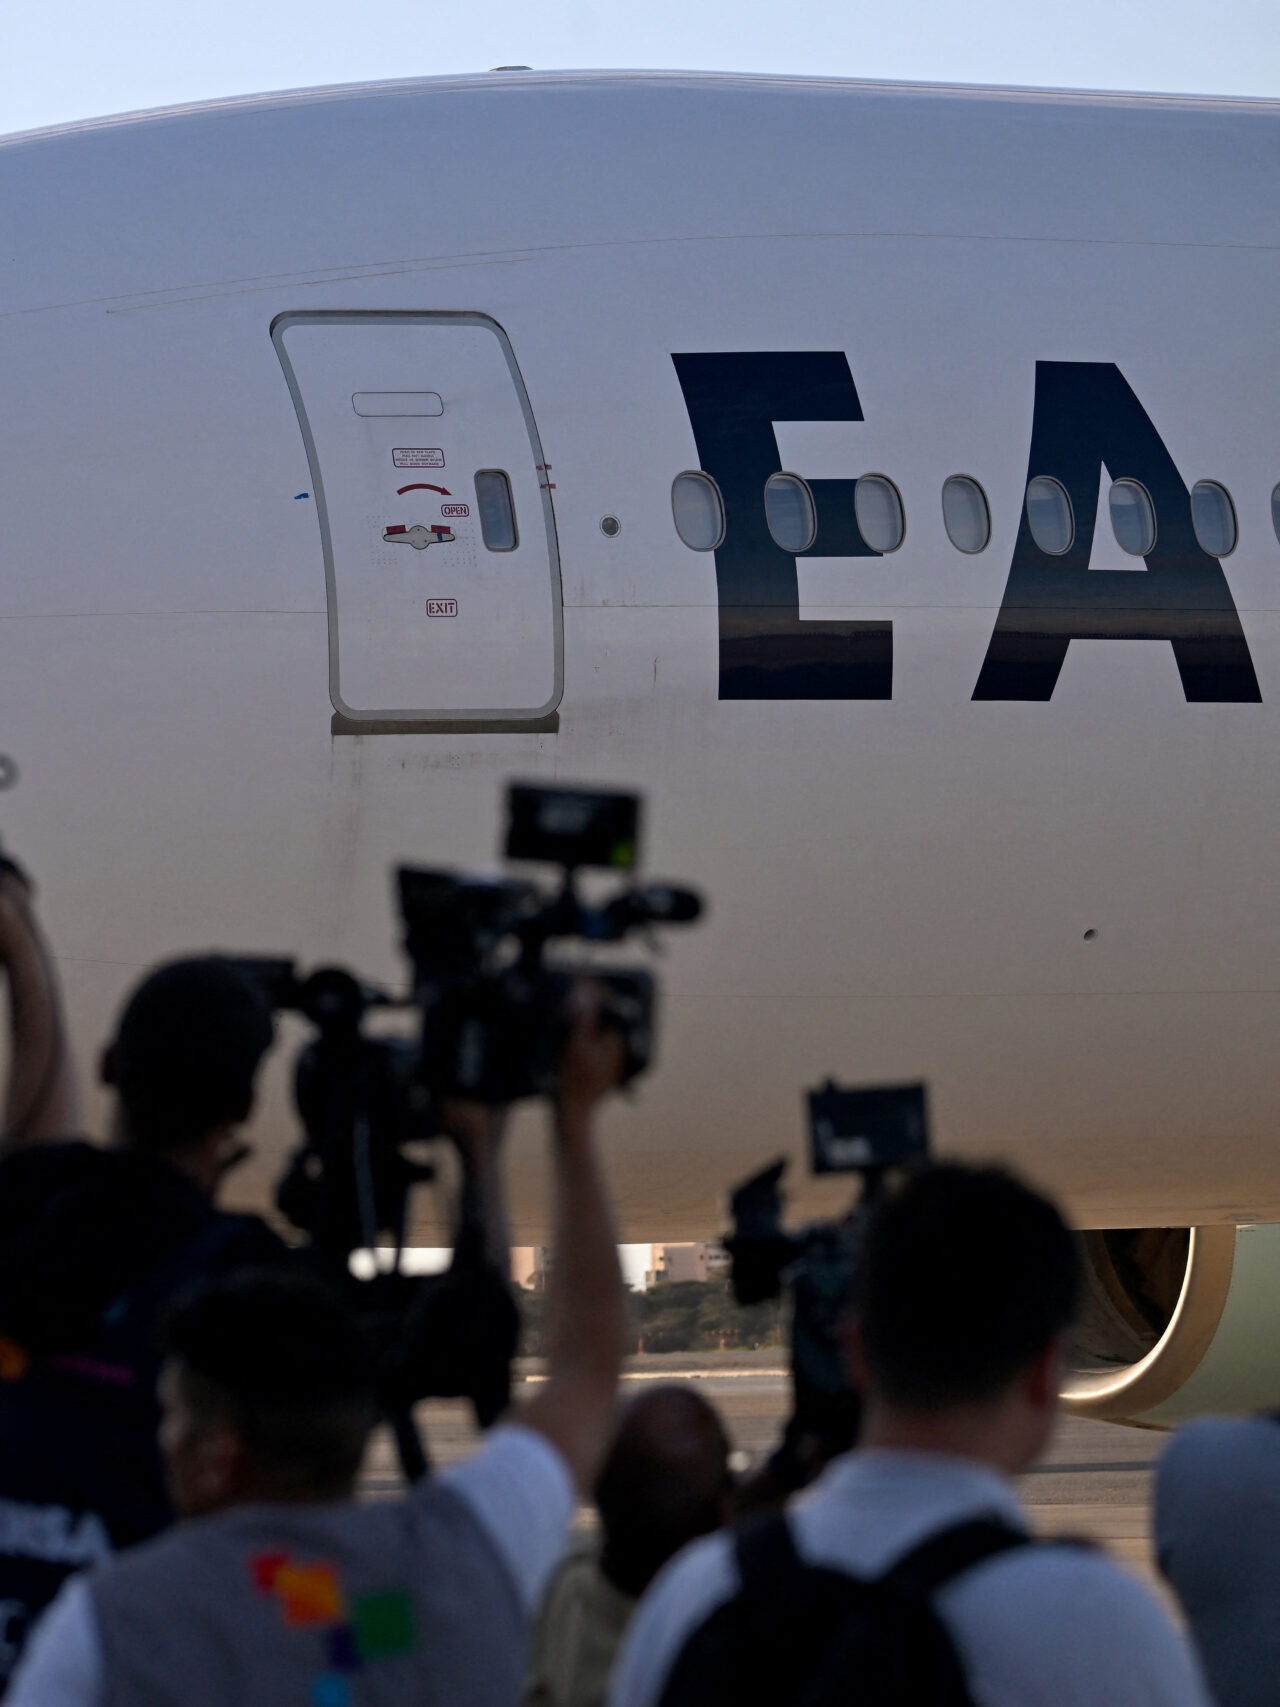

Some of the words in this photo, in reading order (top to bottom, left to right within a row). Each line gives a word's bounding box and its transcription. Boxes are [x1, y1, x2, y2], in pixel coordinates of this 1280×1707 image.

[443, 506, 467, 516] OPEN
[670, 350, 1264, 704] EA
[428, 602, 455, 614] EXIT
